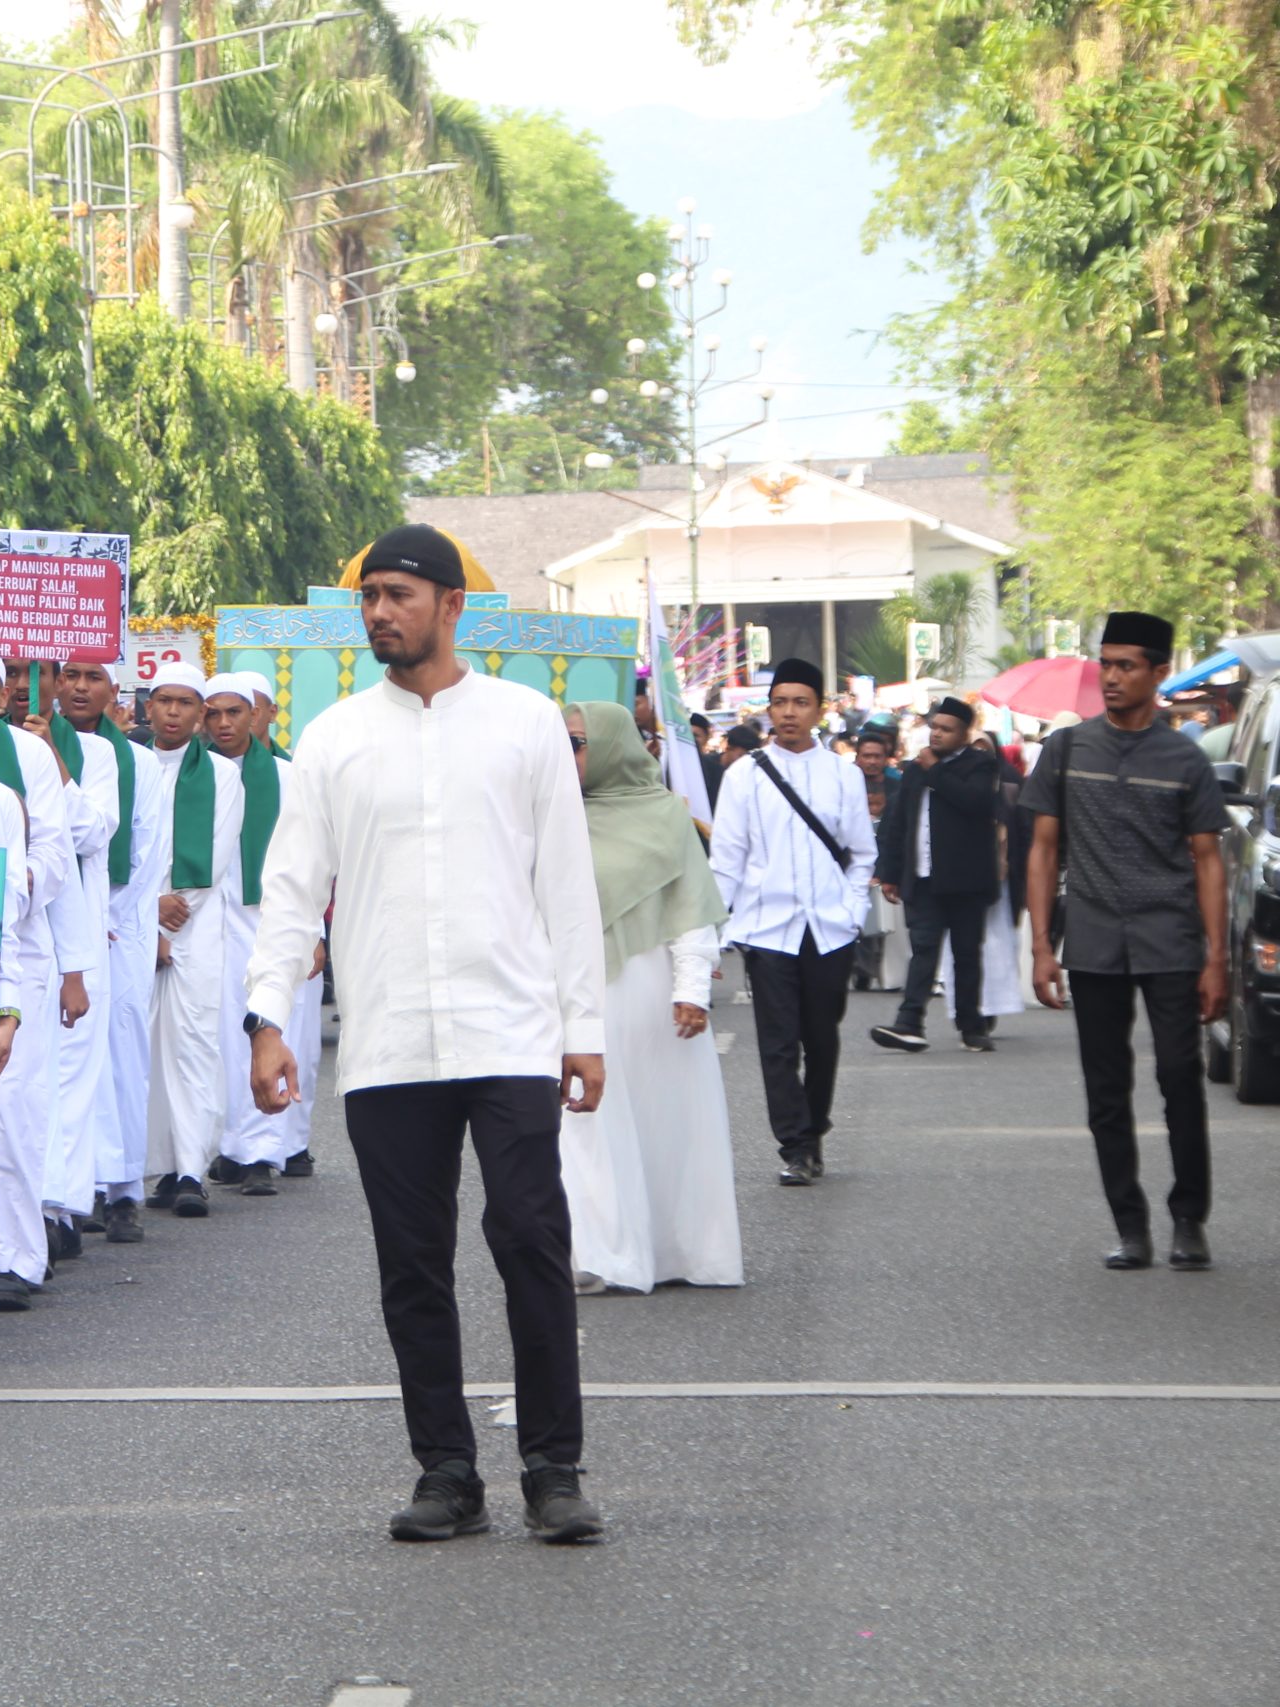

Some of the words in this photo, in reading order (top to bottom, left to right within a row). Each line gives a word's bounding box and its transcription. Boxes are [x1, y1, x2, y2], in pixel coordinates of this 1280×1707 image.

[11, 560, 60, 576] MANUSIA
[63, 563, 106, 578] PERNAH
[41, 579, 79, 595] SALAH,
[7, 593, 36, 608] YANG
[38, 596, 76, 610] PALING
[79, 598, 105, 612] BAIK
[22, 611, 70, 627] BERBUAT
[72, 614, 107, 629] SALAH
[27, 628, 51, 642] MAU
